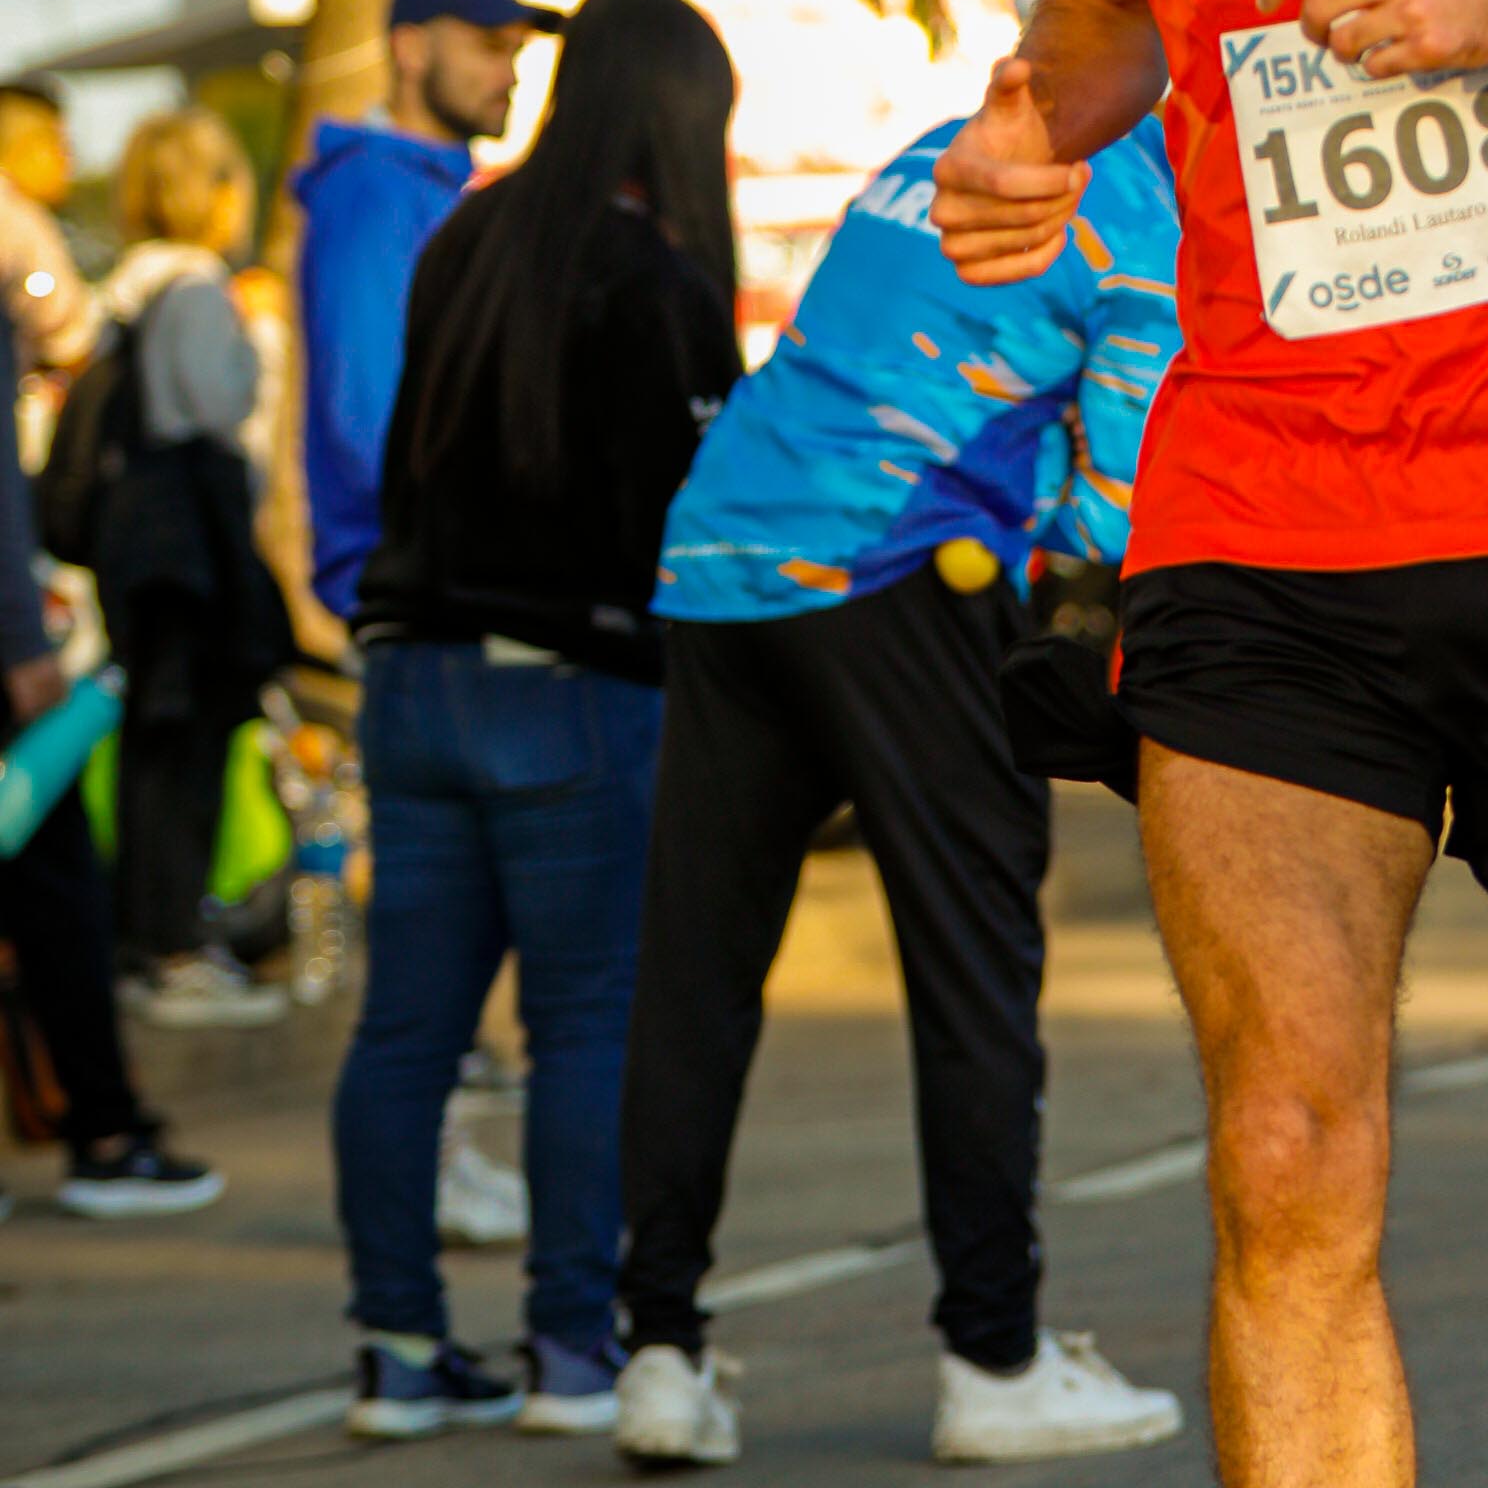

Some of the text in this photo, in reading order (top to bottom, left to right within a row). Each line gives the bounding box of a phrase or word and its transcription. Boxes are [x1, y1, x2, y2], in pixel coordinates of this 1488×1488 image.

[1253, 48, 1334, 99] 15K
[1334, 201, 1487, 245] Rolandi Lautaro
[1309, 263, 1409, 310] osde
